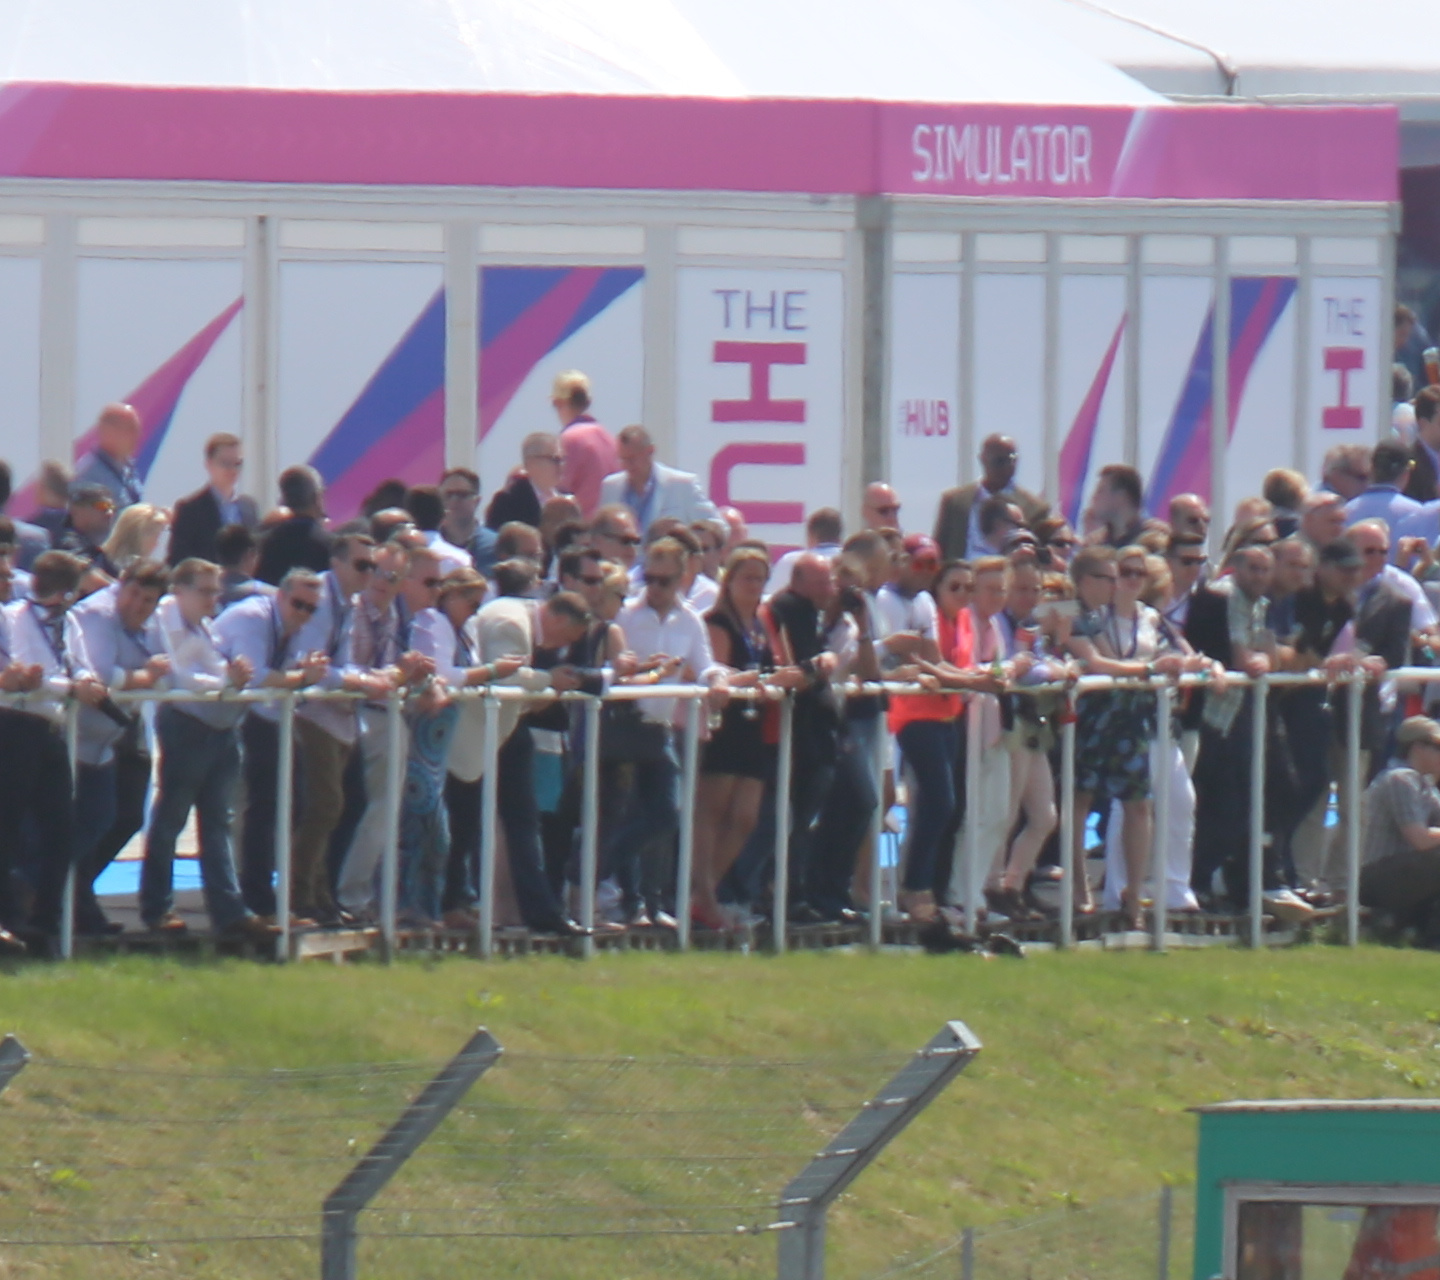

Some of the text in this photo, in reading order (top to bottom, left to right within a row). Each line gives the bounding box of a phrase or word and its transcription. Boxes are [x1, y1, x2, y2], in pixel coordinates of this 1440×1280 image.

[912, 123, 1093, 184] SIMULATOR
[711, 288, 808, 331] THE
[1323, 296, 1366, 335] THE
[905, 399, 950, 437] HUB
[707, 339, 807, 565] HU
